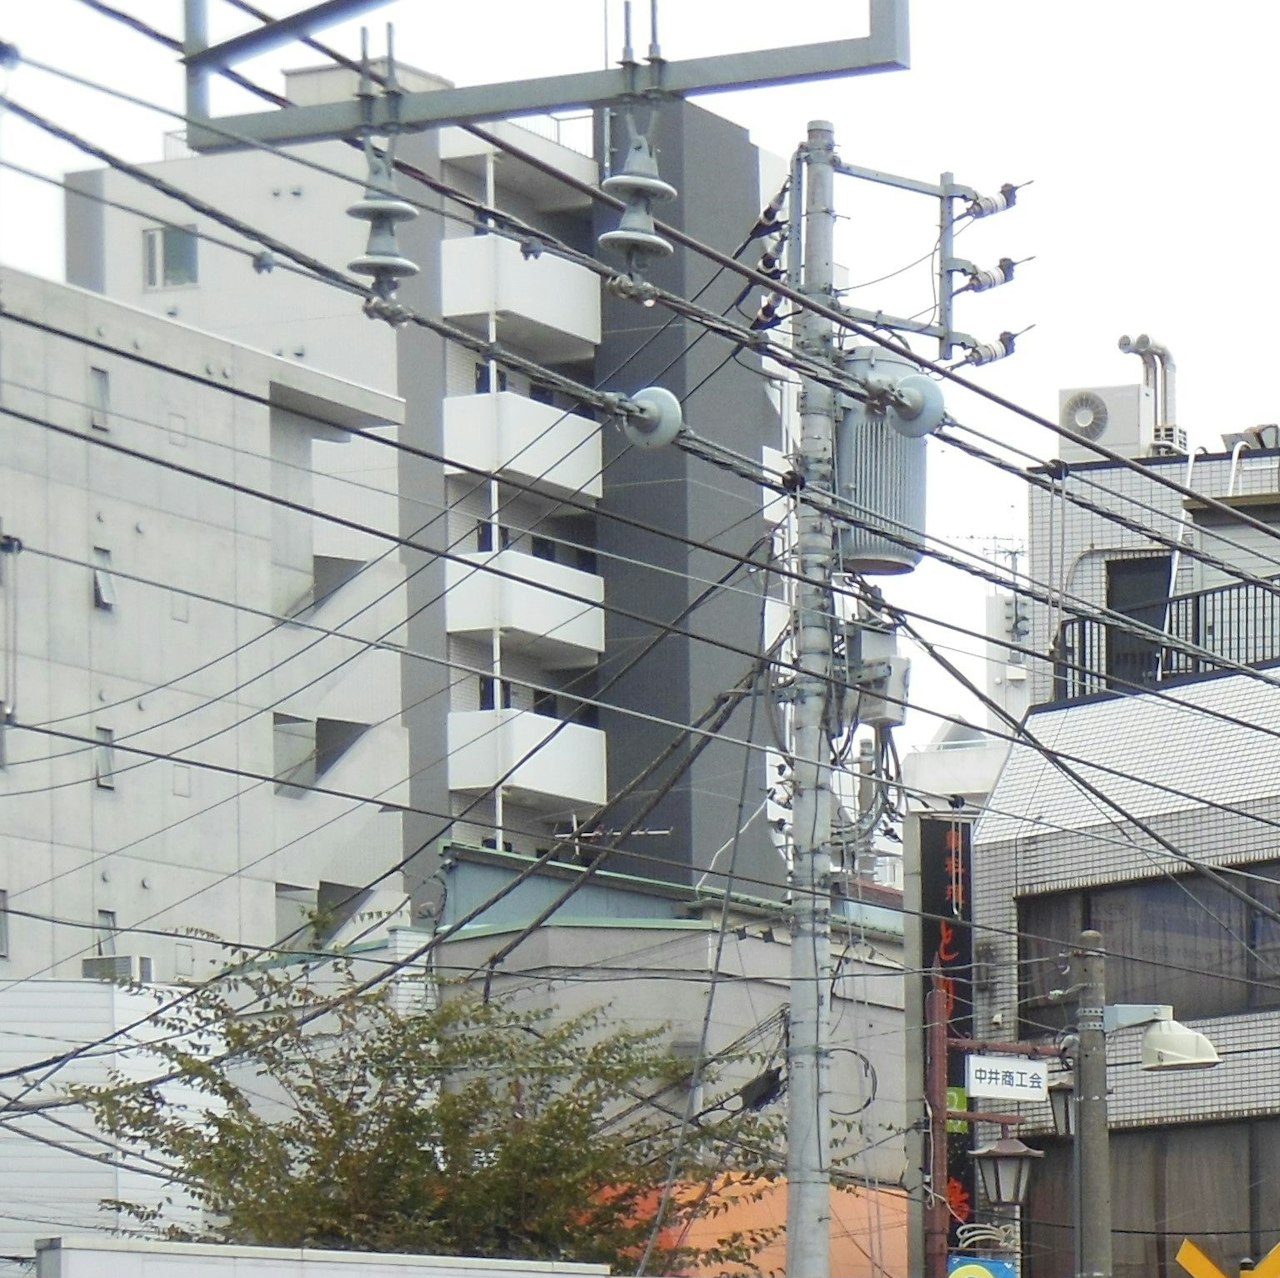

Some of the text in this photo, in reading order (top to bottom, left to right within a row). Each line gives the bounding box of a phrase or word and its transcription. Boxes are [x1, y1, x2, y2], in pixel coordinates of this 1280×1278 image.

[974, 1068, 1043, 1089] 中井商工会
